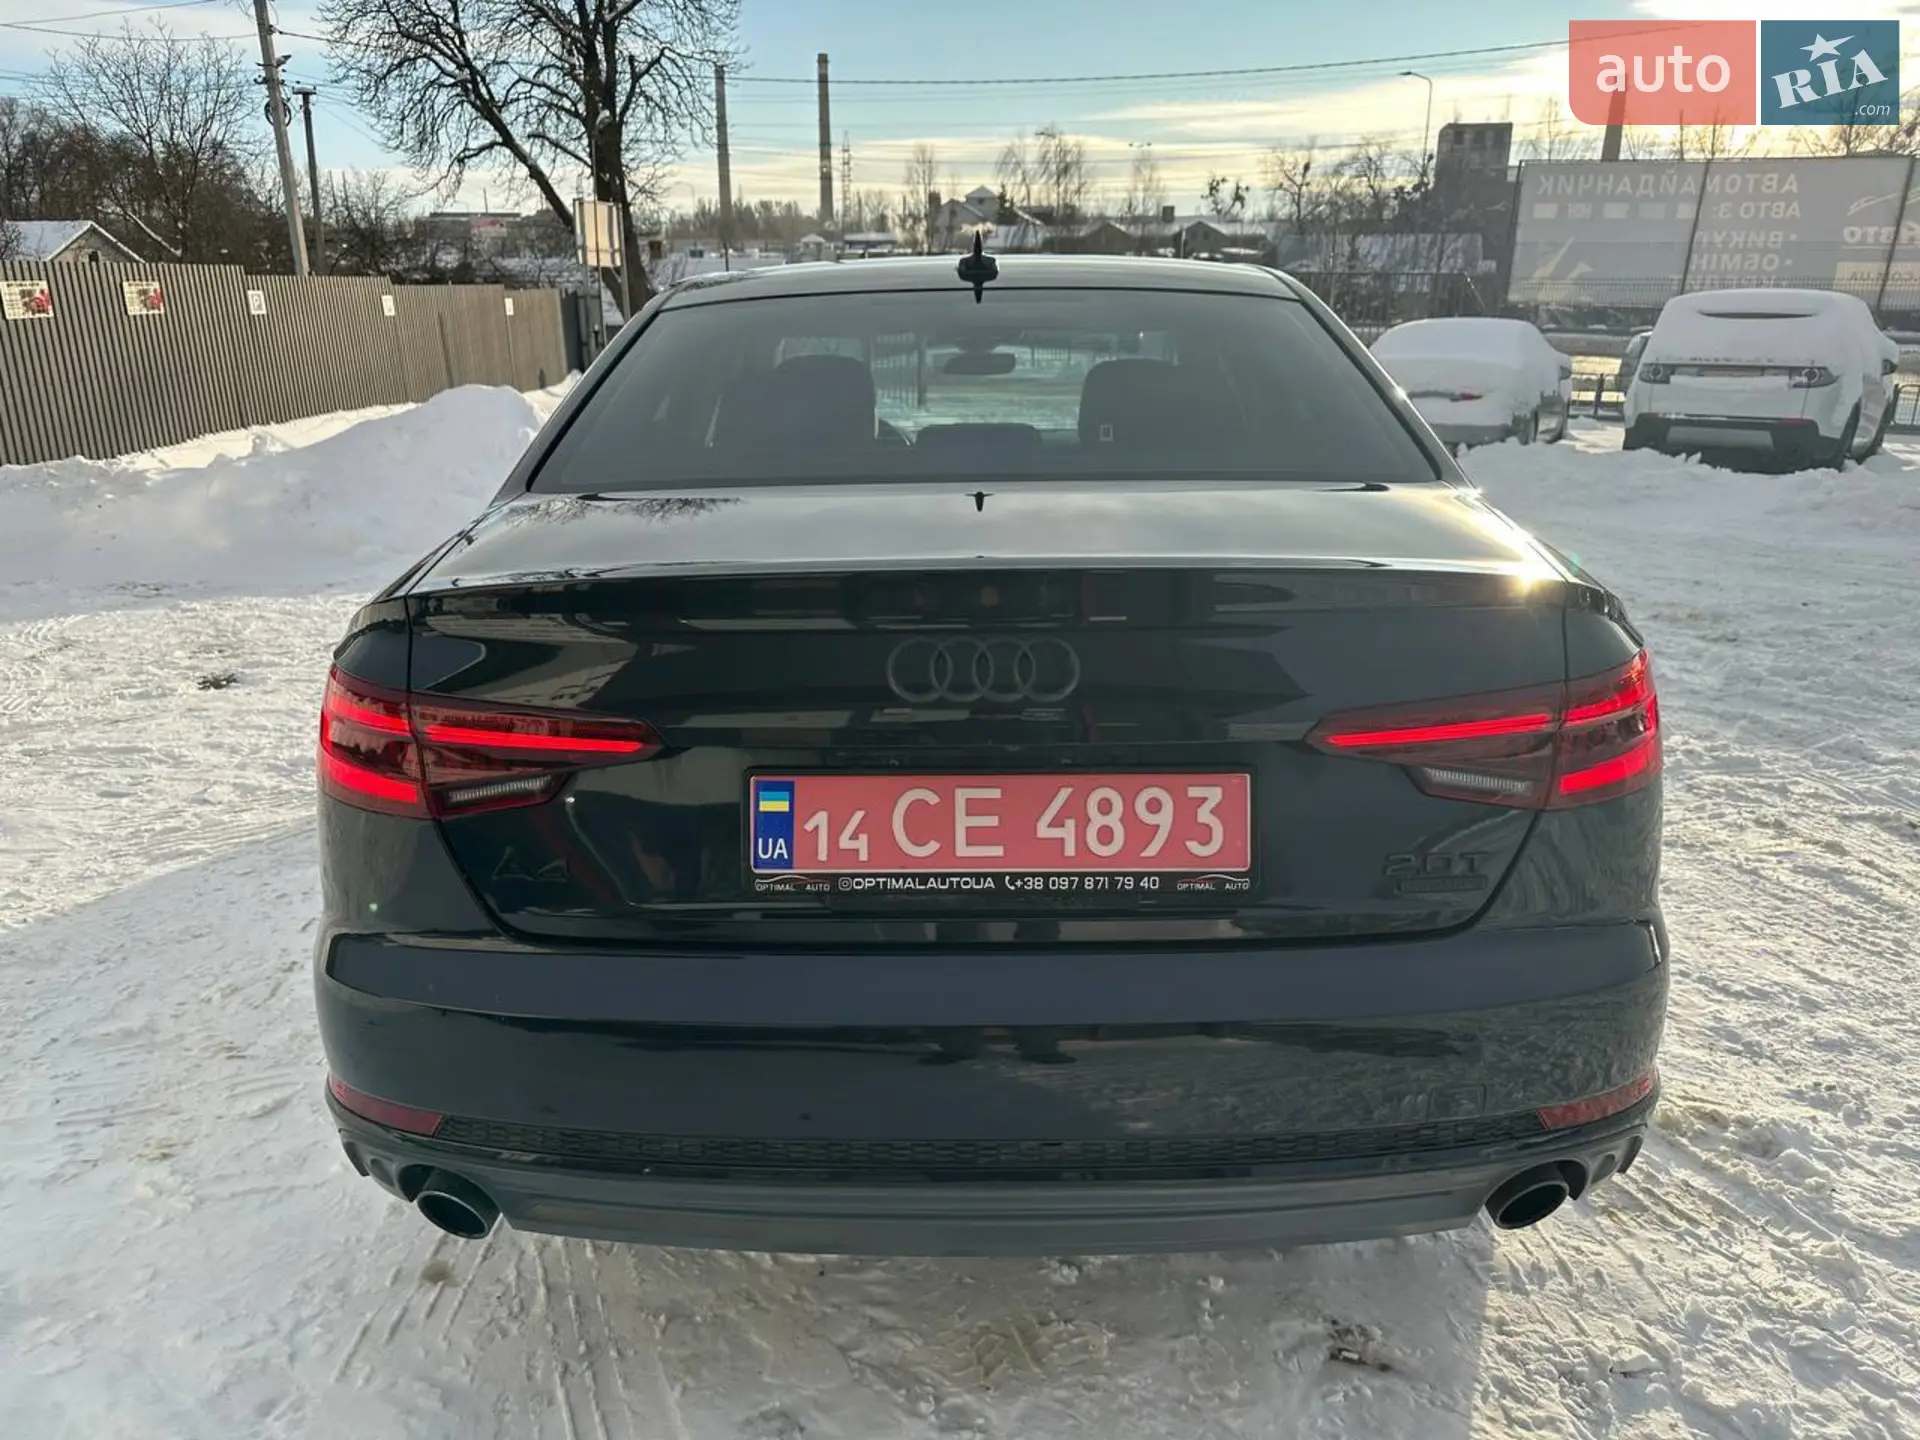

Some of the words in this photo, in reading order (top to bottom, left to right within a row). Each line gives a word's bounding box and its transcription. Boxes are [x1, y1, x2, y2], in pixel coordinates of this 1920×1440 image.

[803, 810, 869, 862] 14
[892, 787, 1004, 858] CE
[1036, 786, 1224, 858] 4893
[758, 838, 789, 859] UA
[755, 883, 796, 892] OPTIMAL
[806, 883, 831, 892] AUTO
[1015, 876, 1044, 890] +38
[1049, 876, 1078, 890] 097
[1084, 876, 1109, 889] 871
[1115, 876, 1135, 889] 79
[1140, 876, 1159, 889] 40
[1177, 882, 1216, 891] OPTIMAL
[1225, 882, 1249, 891] AUTO
